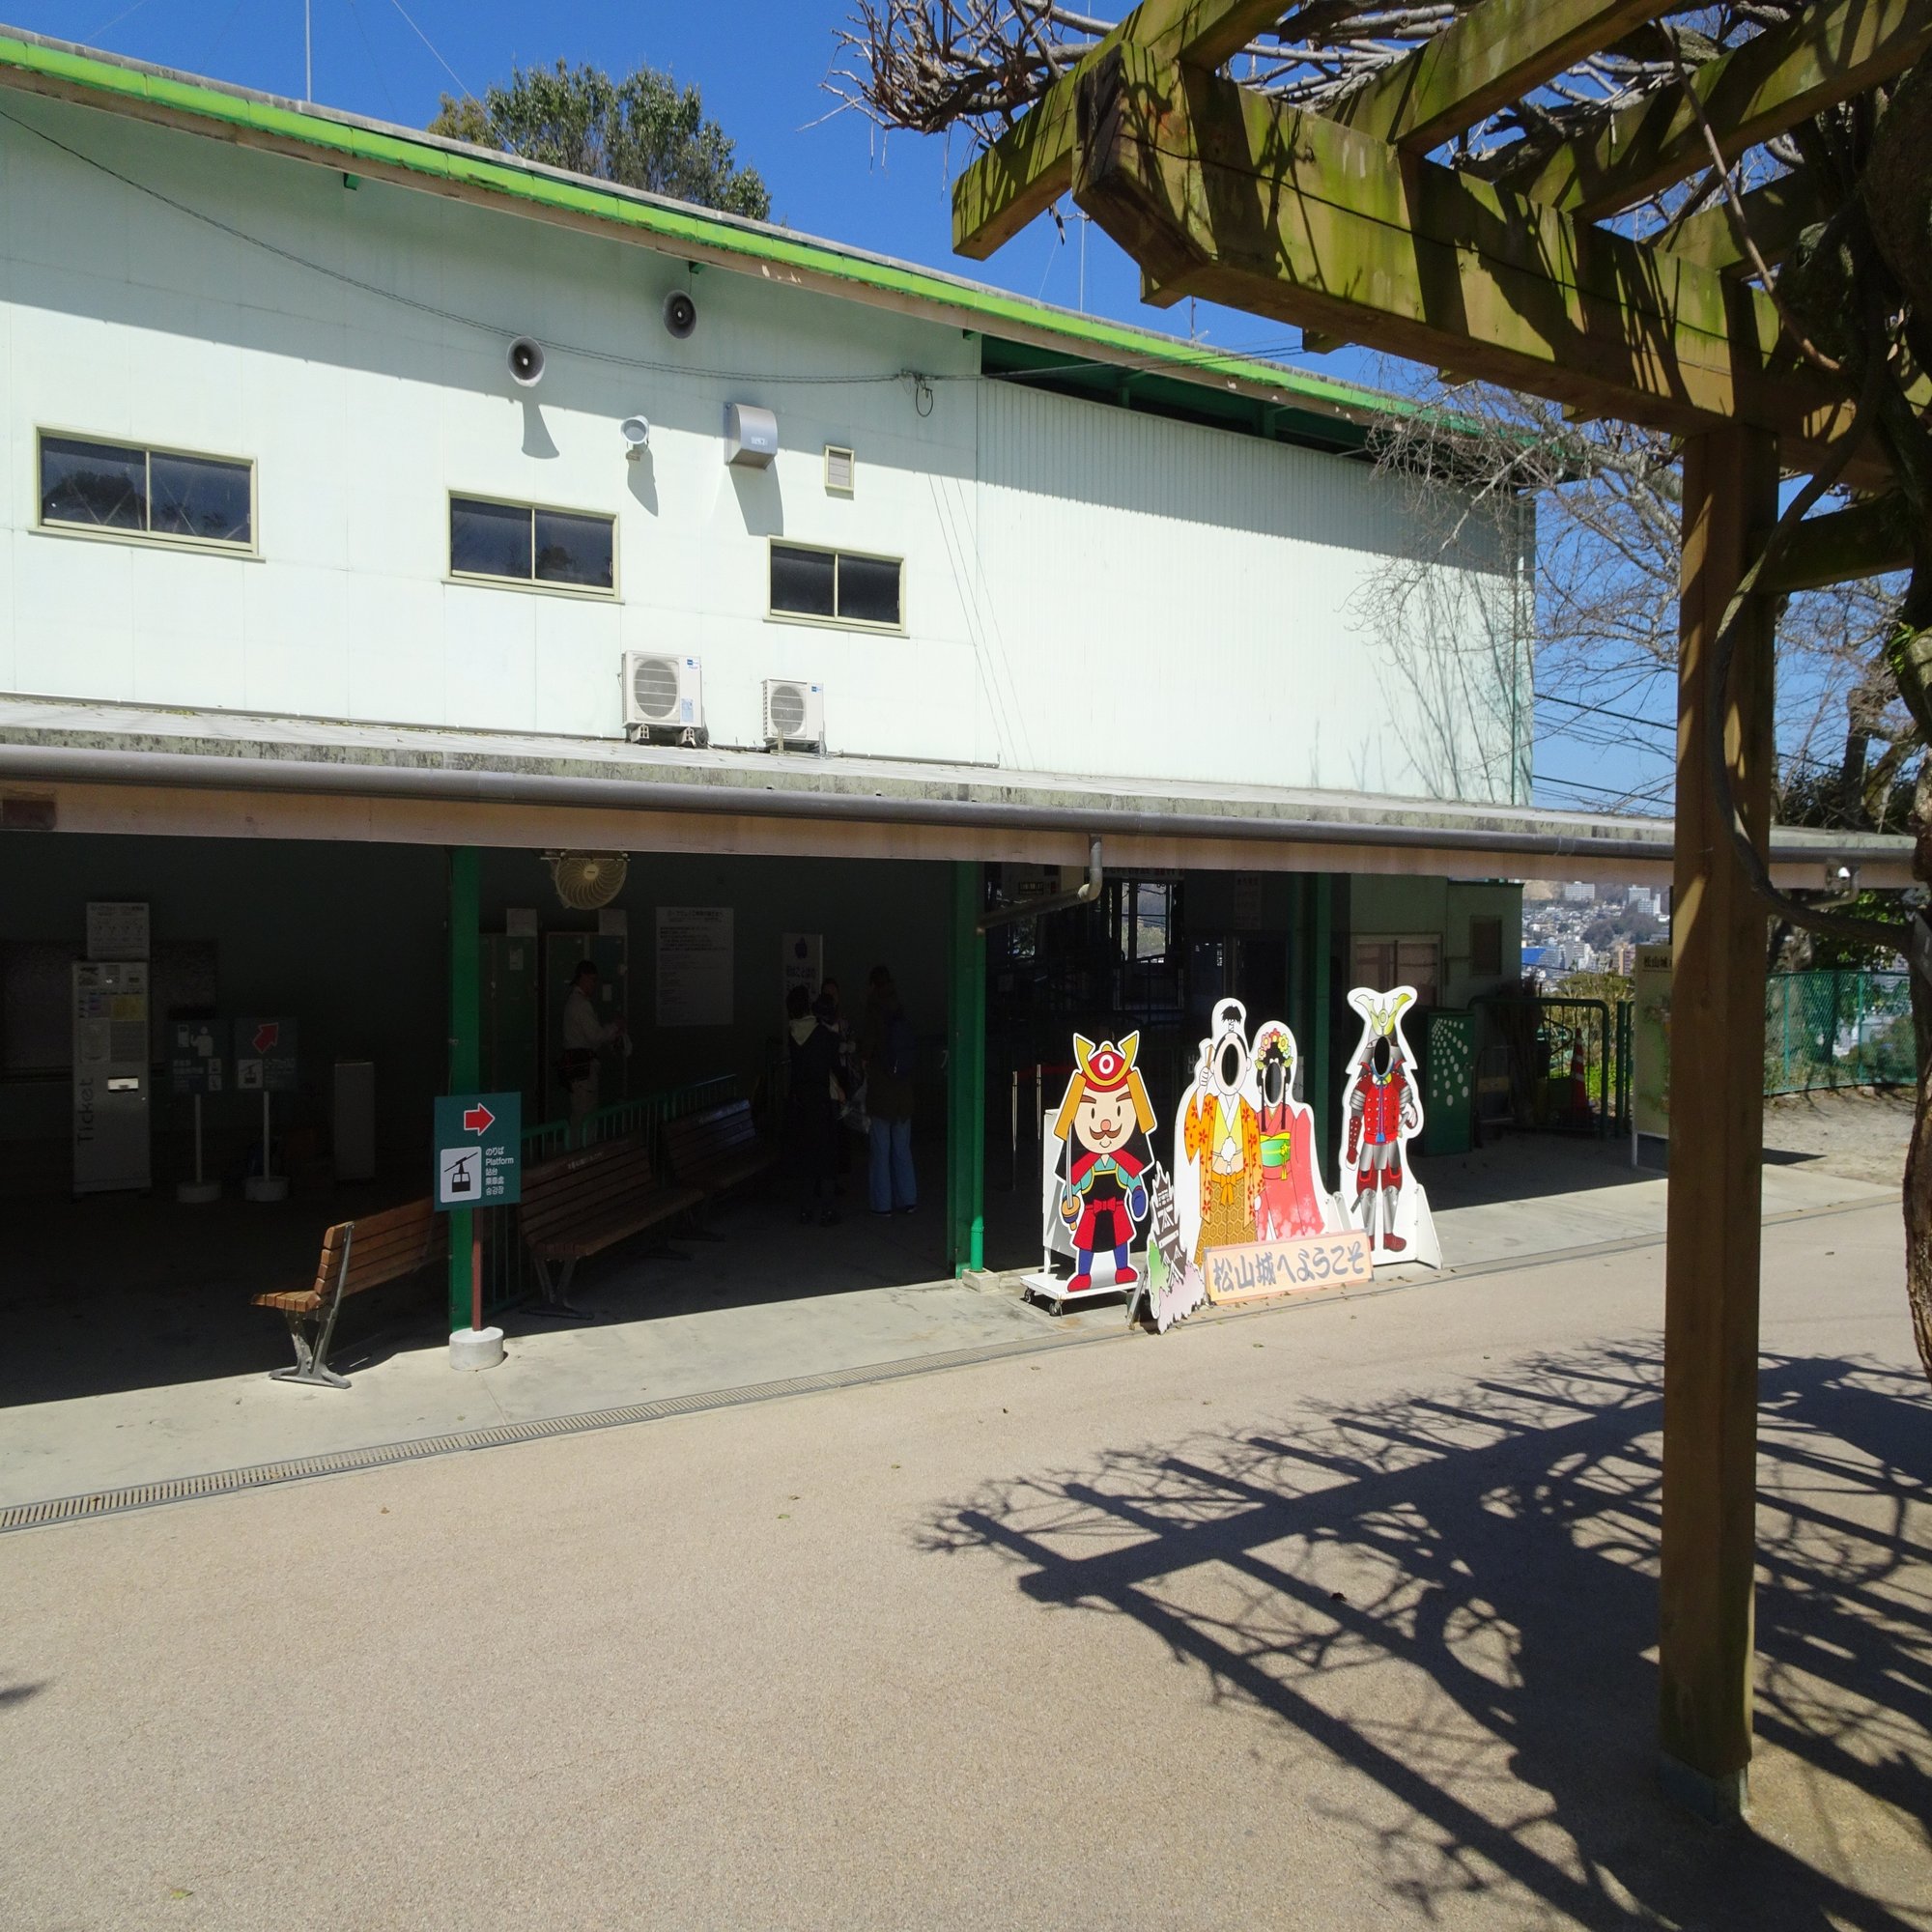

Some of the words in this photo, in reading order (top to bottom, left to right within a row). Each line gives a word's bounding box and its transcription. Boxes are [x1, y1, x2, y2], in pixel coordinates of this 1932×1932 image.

[77, 1078, 94, 1147] Ticket
[485, 1147, 504, 1156] のりば
[485, 1157, 514, 1166] Platform
[1213, 1240, 1364, 1293] 松山城へようこそ
